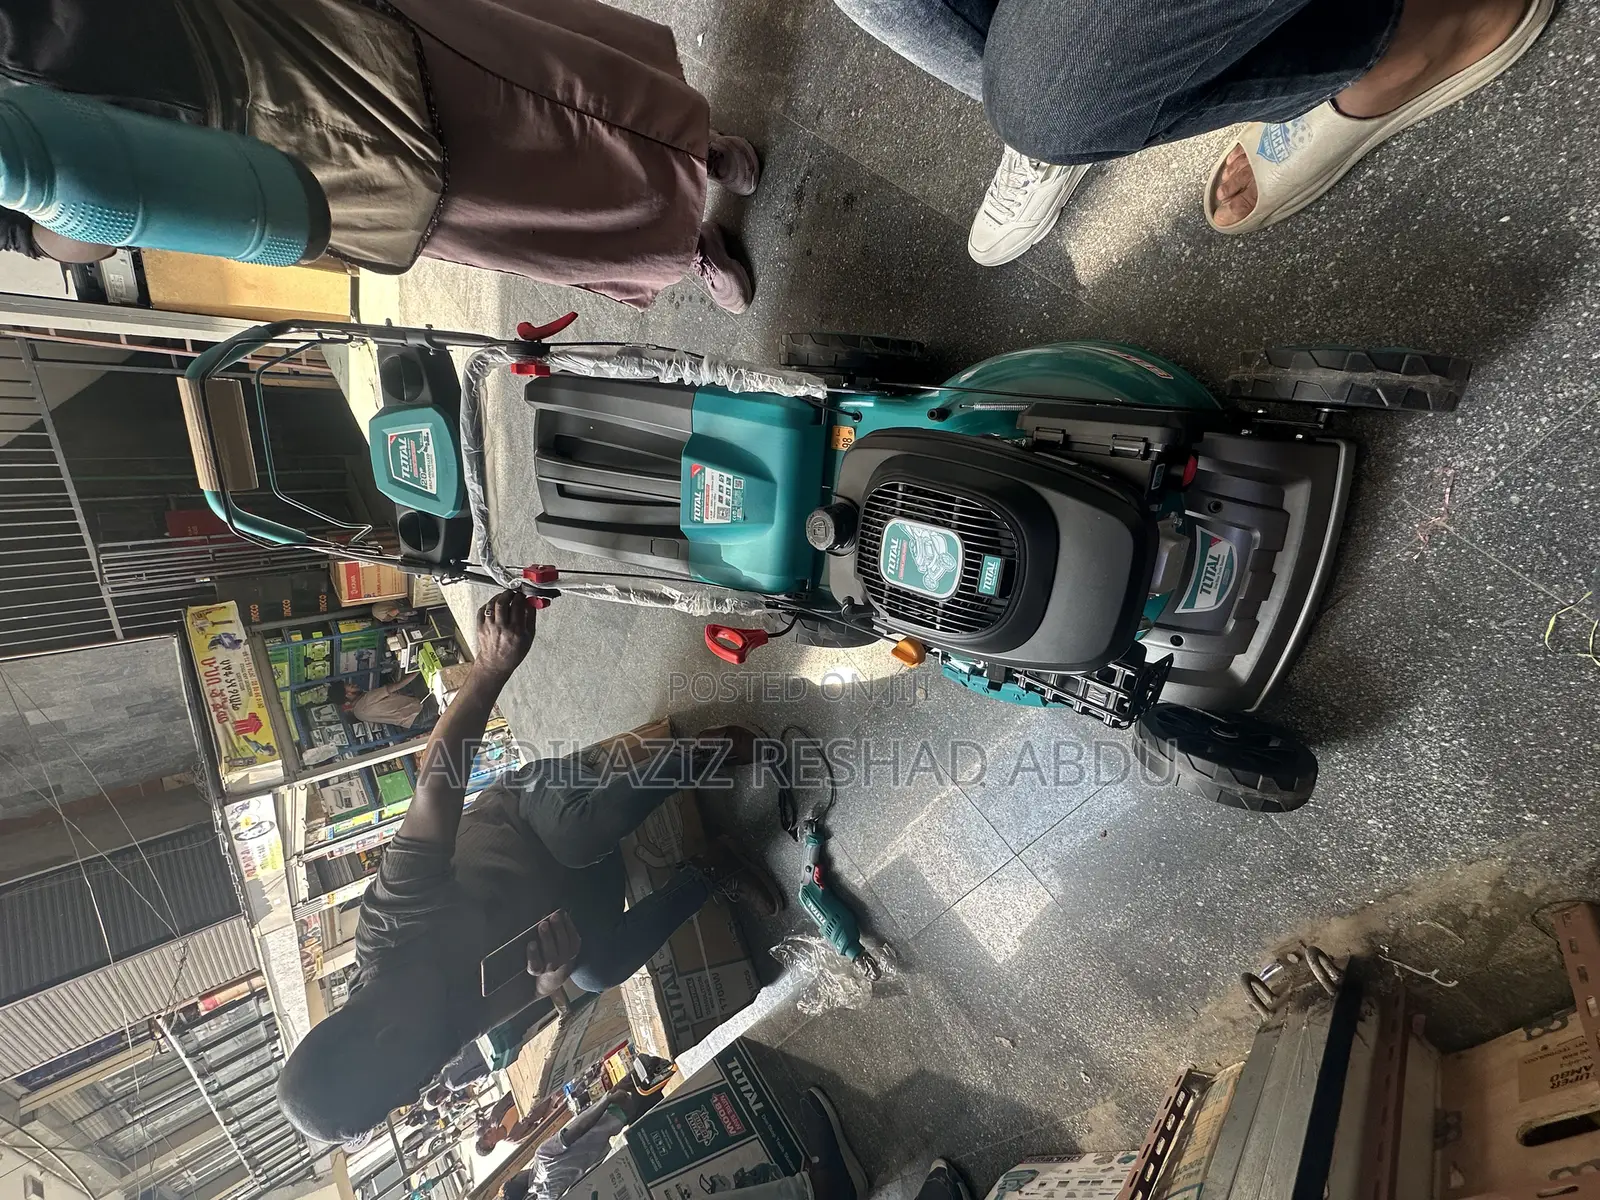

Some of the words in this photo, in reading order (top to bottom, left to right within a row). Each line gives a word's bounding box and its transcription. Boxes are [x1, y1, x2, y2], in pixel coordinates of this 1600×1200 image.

[1270, 123, 1289, 161] OCCER
[398, 437, 410, 478] TOTAL
[842, 436, 853, 448] 98
[887, 536, 900, 575] TOTAL
[1200, 554, 1221, 595] TOTAL
[983, 561, 996, 590] TOTAL
[808, 900, 827, 925] TOTAL
[658, 964, 690, 1033] TOTAL
[687, 978, 702, 1018] INDUSTRIAL
[697, 976, 711, 1015] DEMOLITION
[712, 973, 728, 1010] 1700W
[726, 1056, 764, 1116] TOTAL
[712, 1095, 737, 1136] 1800W
[719, 1094, 735, 1114] MITRE
[729, 1113, 741, 1131] SAW
